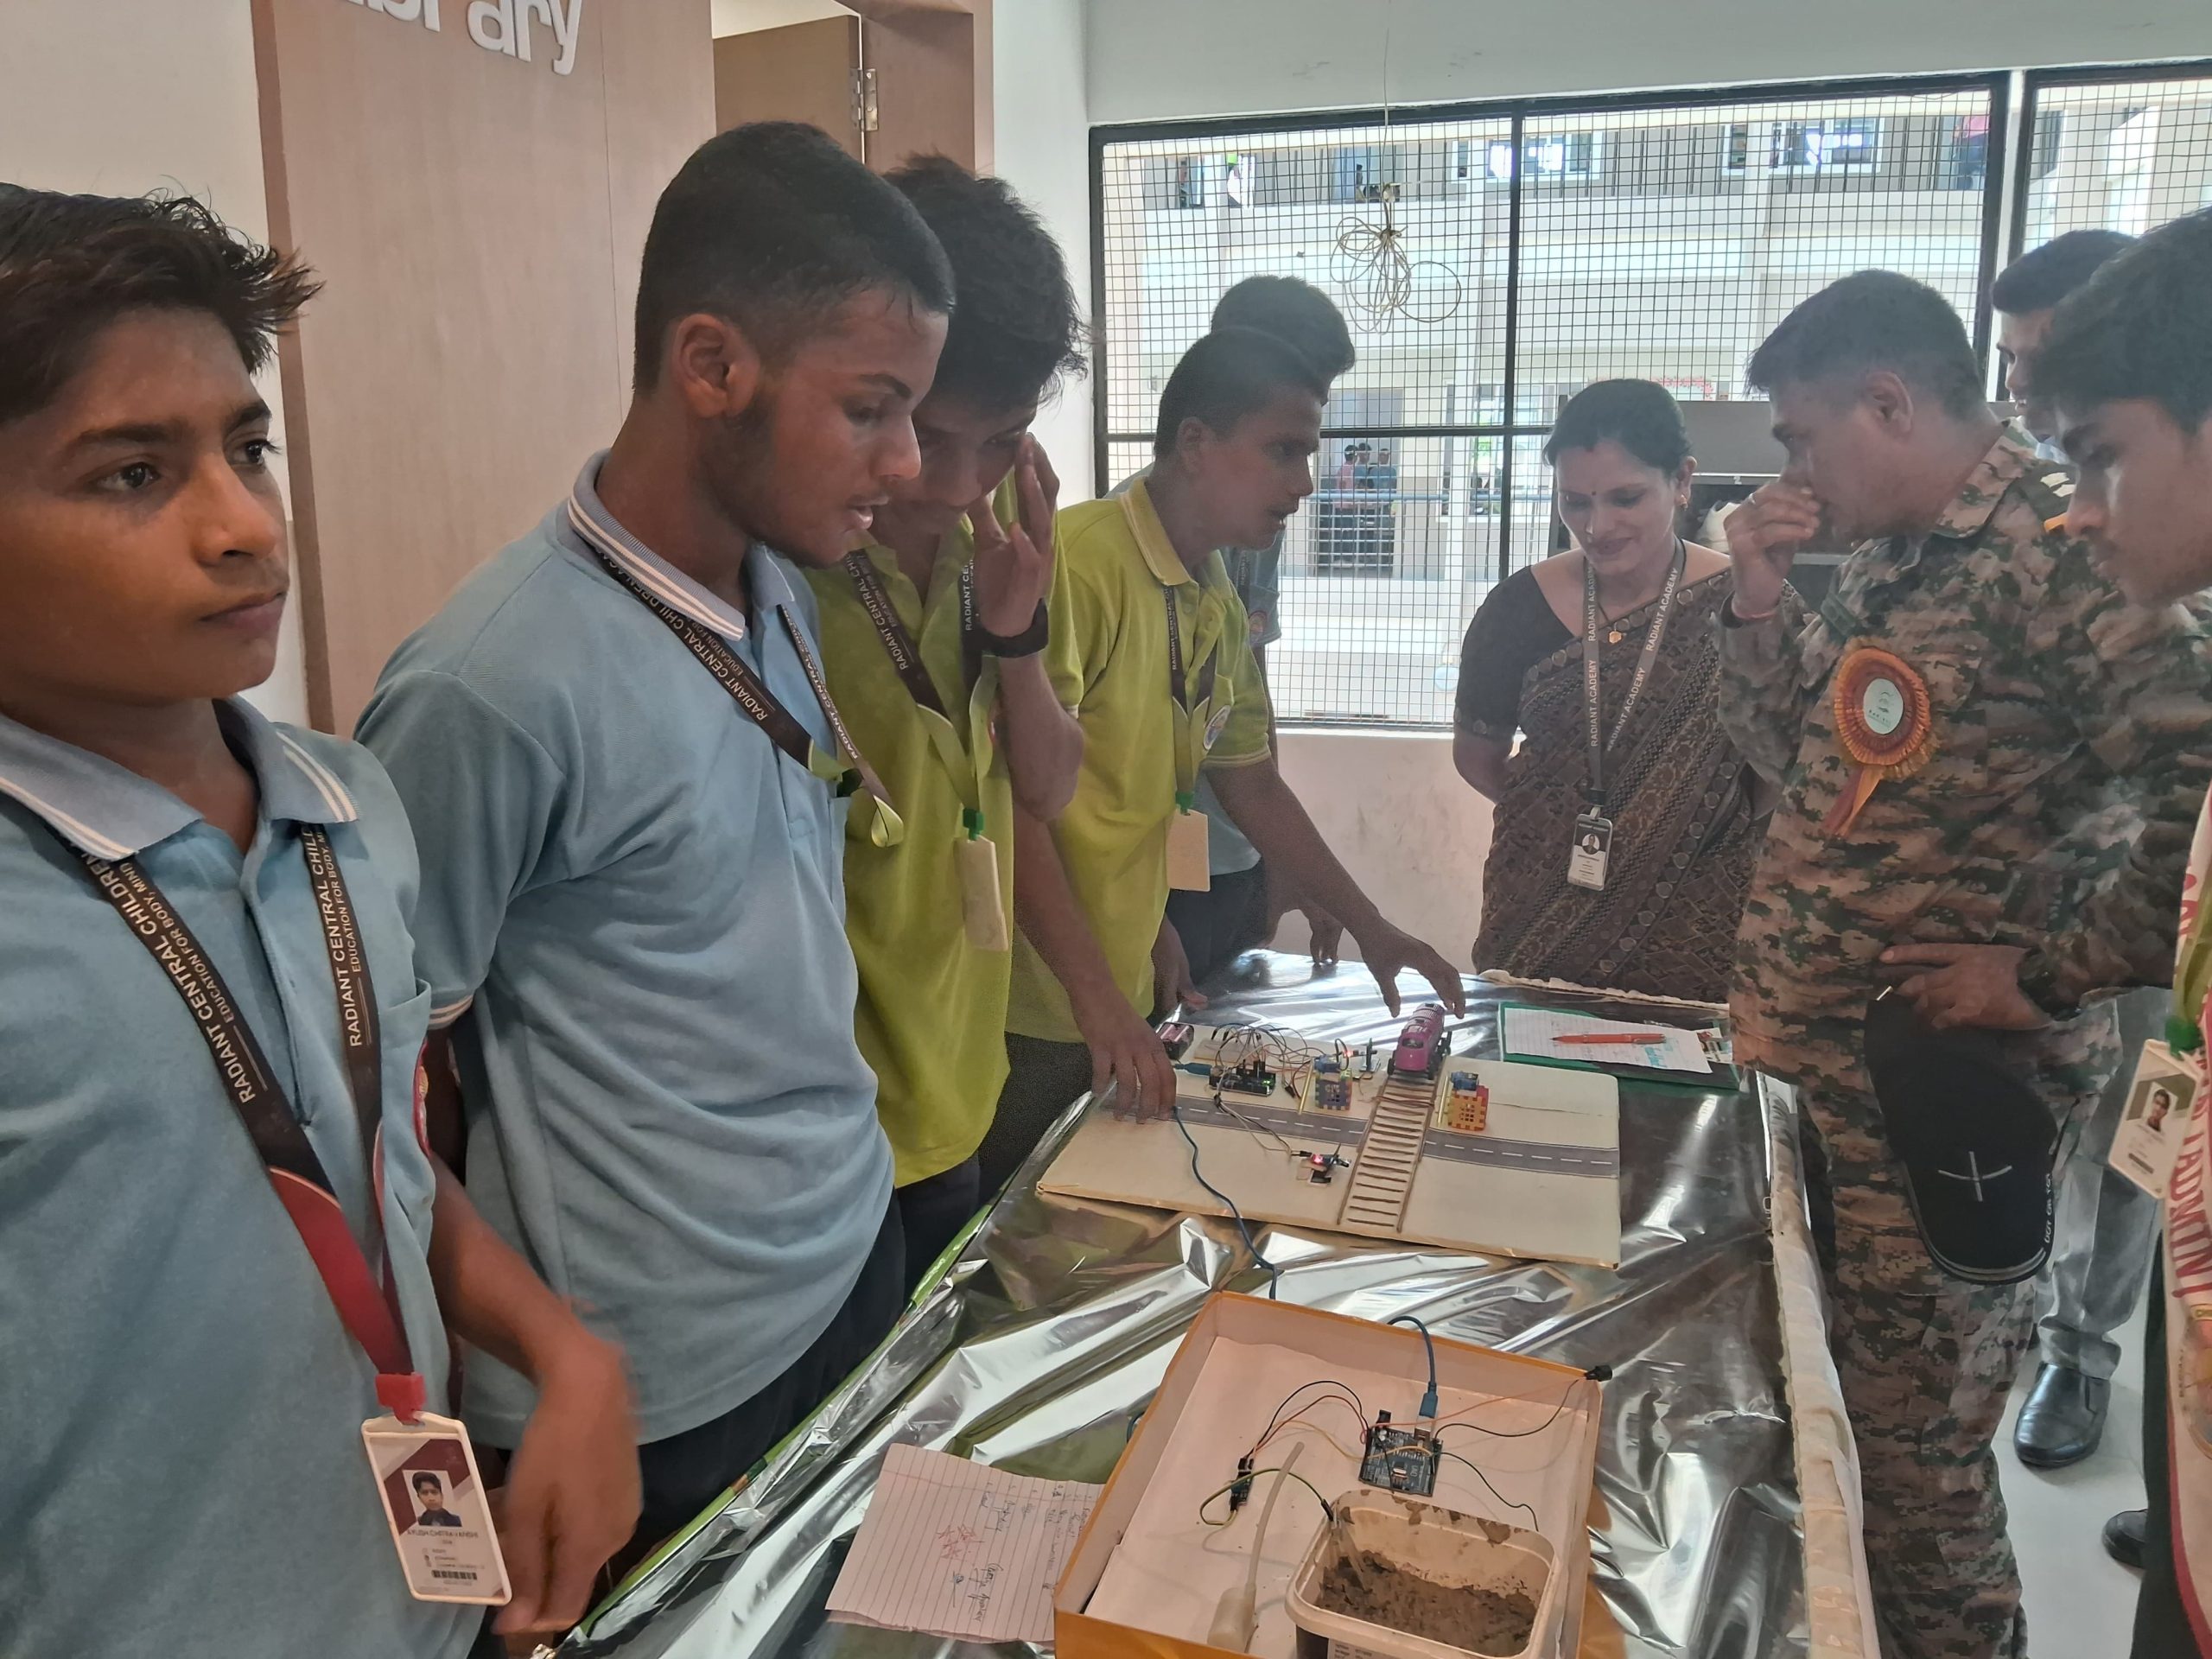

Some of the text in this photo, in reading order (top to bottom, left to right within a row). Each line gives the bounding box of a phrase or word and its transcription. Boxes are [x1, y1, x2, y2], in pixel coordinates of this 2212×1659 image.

[857, 578, 886, 626] CENTRAL
[963, 585, 973, 631] RADIANT
[1587, 604, 1597, 641] RADIANT
[1645, 567, 1679, 652] RADIANT ACADEMY
[683, 628, 728, 677] CENTRAL
[708, 634, 744, 676] EDUCATION
[880, 628, 909, 671] RADIANT
[725, 679, 767, 721] RADIANT
[805, 658, 831, 709] CENTRAL
[1588, 659, 1599, 747] RADIANT ACADEMY
[1624, 666, 1647, 713] ACADEMY
[829, 711, 858, 760] RADIANT
[143, 892, 175, 928] BODY,
[331, 881, 345, 904] FOR
[170, 928, 194, 954] FOR
[317, 880, 346, 963] CENTRAL
[338, 906, 362, 973] EDUCATION
[156, 936, 213, 1020] CENTRAL
[189, 954, 235, 1023] EDUCATION
[335, 967, 362, 1047] RADIANT
[206, 1025, 257, 1103] RADIANT
